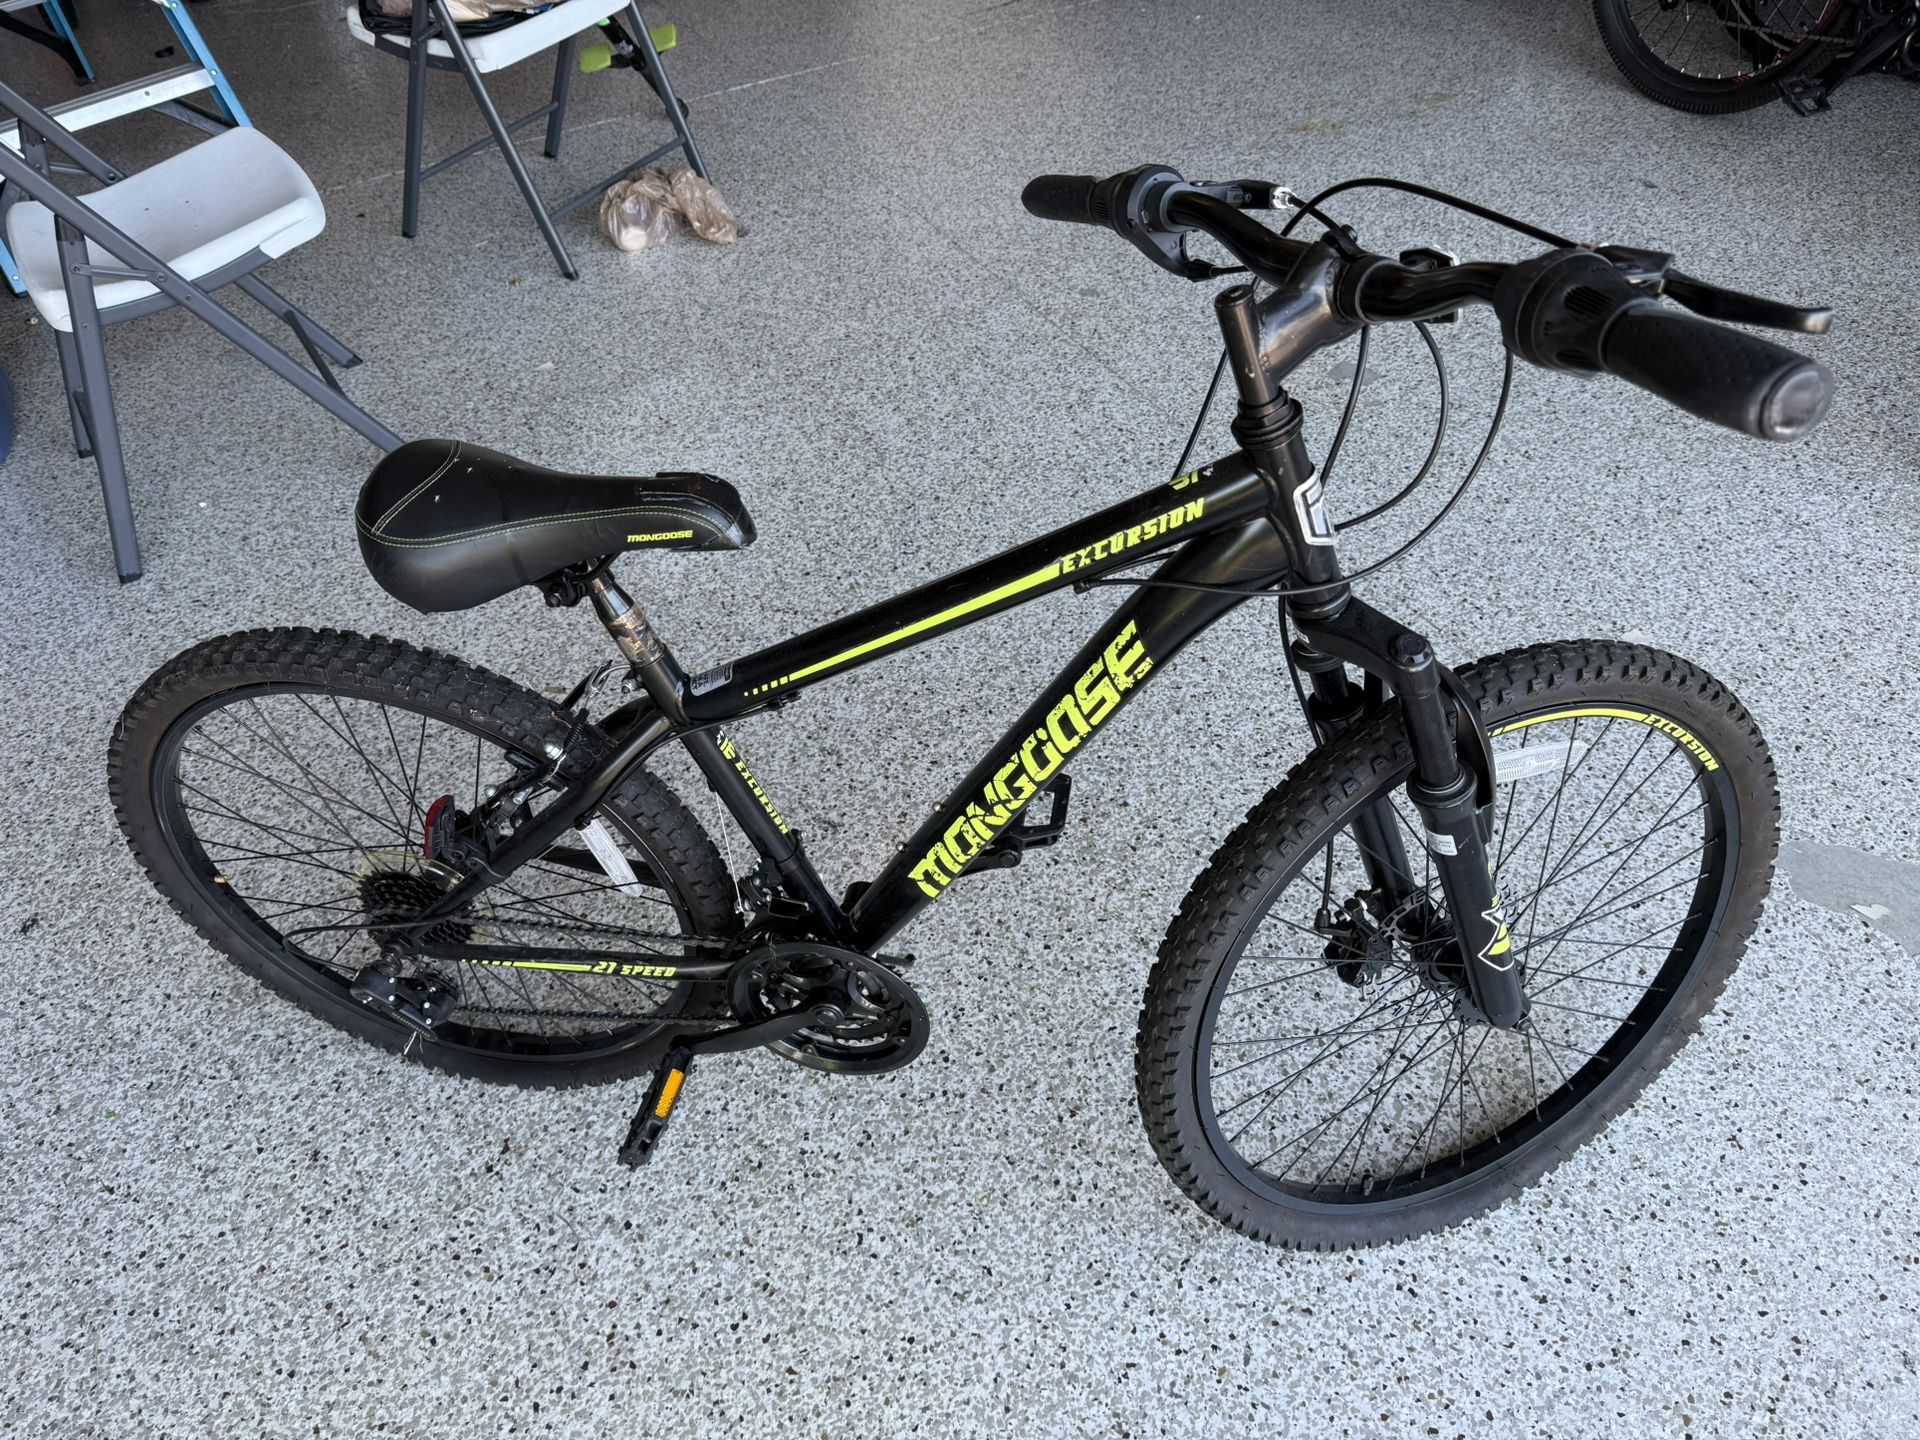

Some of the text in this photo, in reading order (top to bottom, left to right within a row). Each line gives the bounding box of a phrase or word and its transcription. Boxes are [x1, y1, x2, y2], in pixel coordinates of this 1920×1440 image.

[626, 529, 694, 543] MONGOOSE
[1061, 497, 1204, 574] EXCURSION
[907, 619, 1154, 899] MONGOOSE
[1643, 713, 1720, 772] EXCURSION
[735, 759, 790, 835] EXCURSION
[592, 961, 677, 977] 21 SPEED
